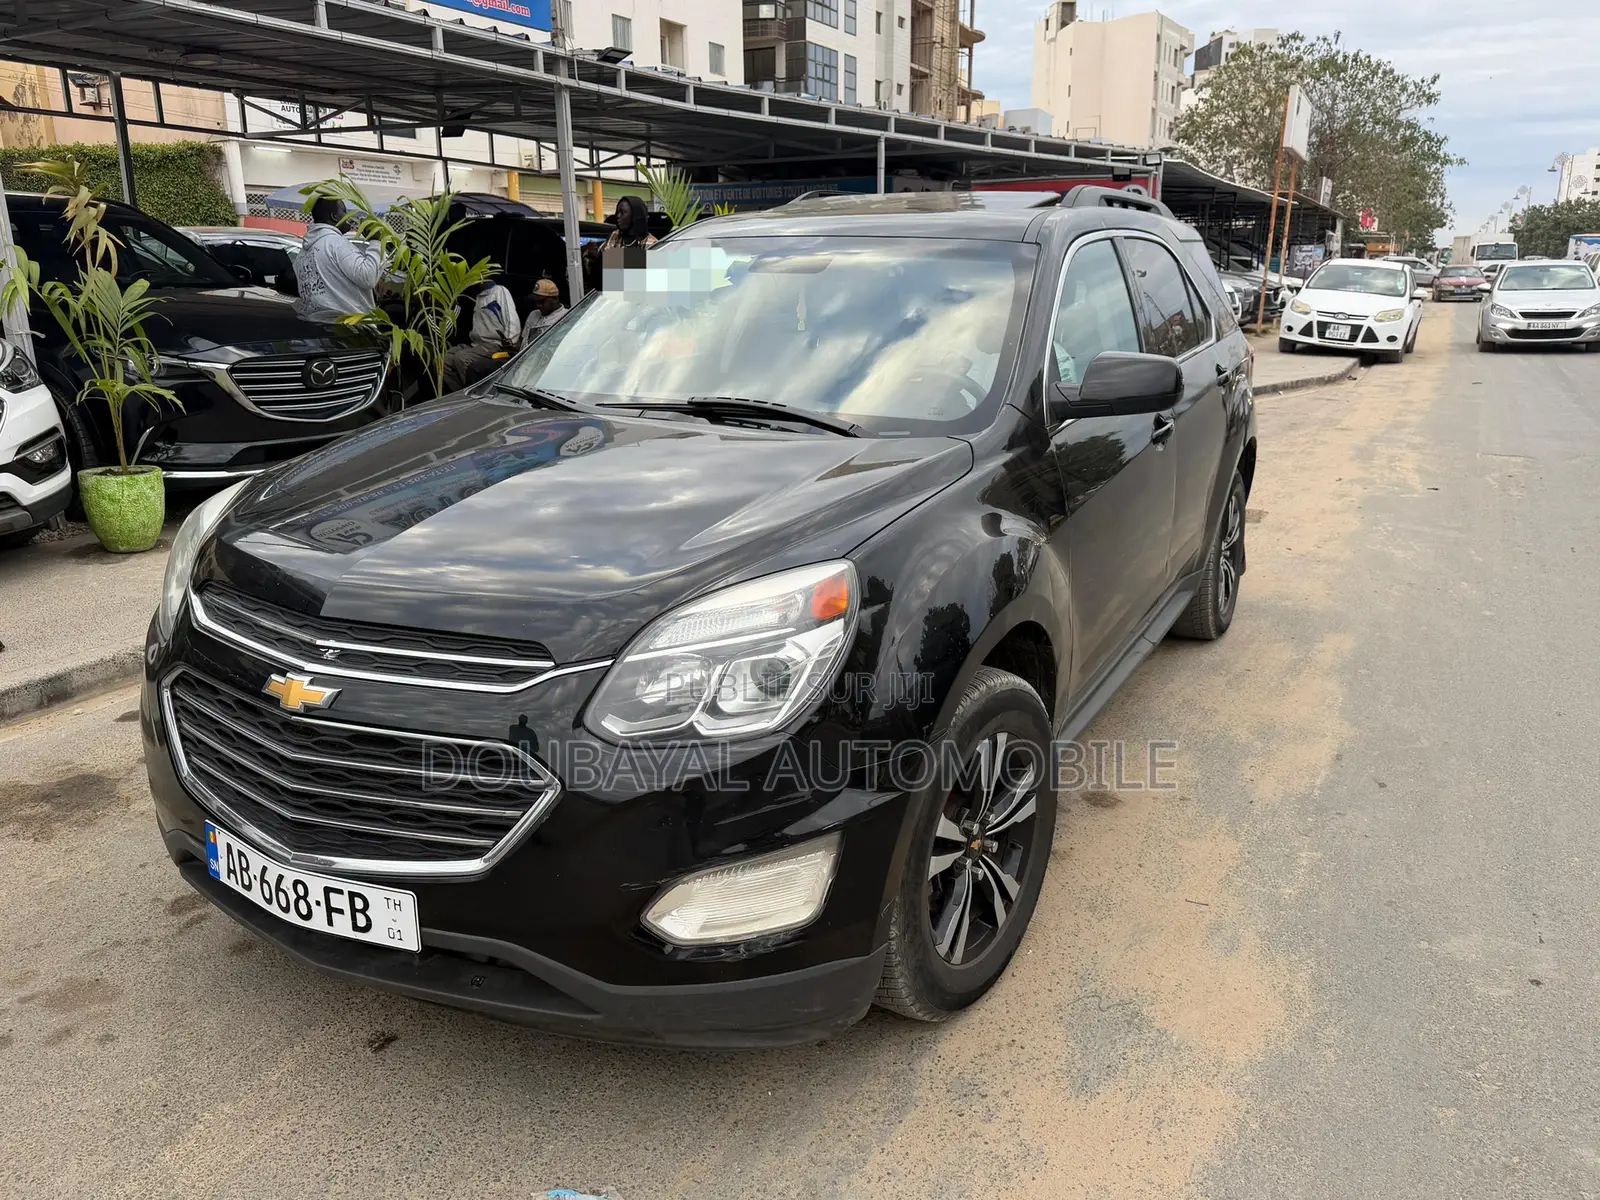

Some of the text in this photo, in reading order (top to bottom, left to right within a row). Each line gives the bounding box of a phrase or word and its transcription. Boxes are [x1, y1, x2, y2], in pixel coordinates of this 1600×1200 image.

[209, 858, 220, 872] SN
[384, 896, 403, 912] TH
[387, 926, 405, 942] 01
